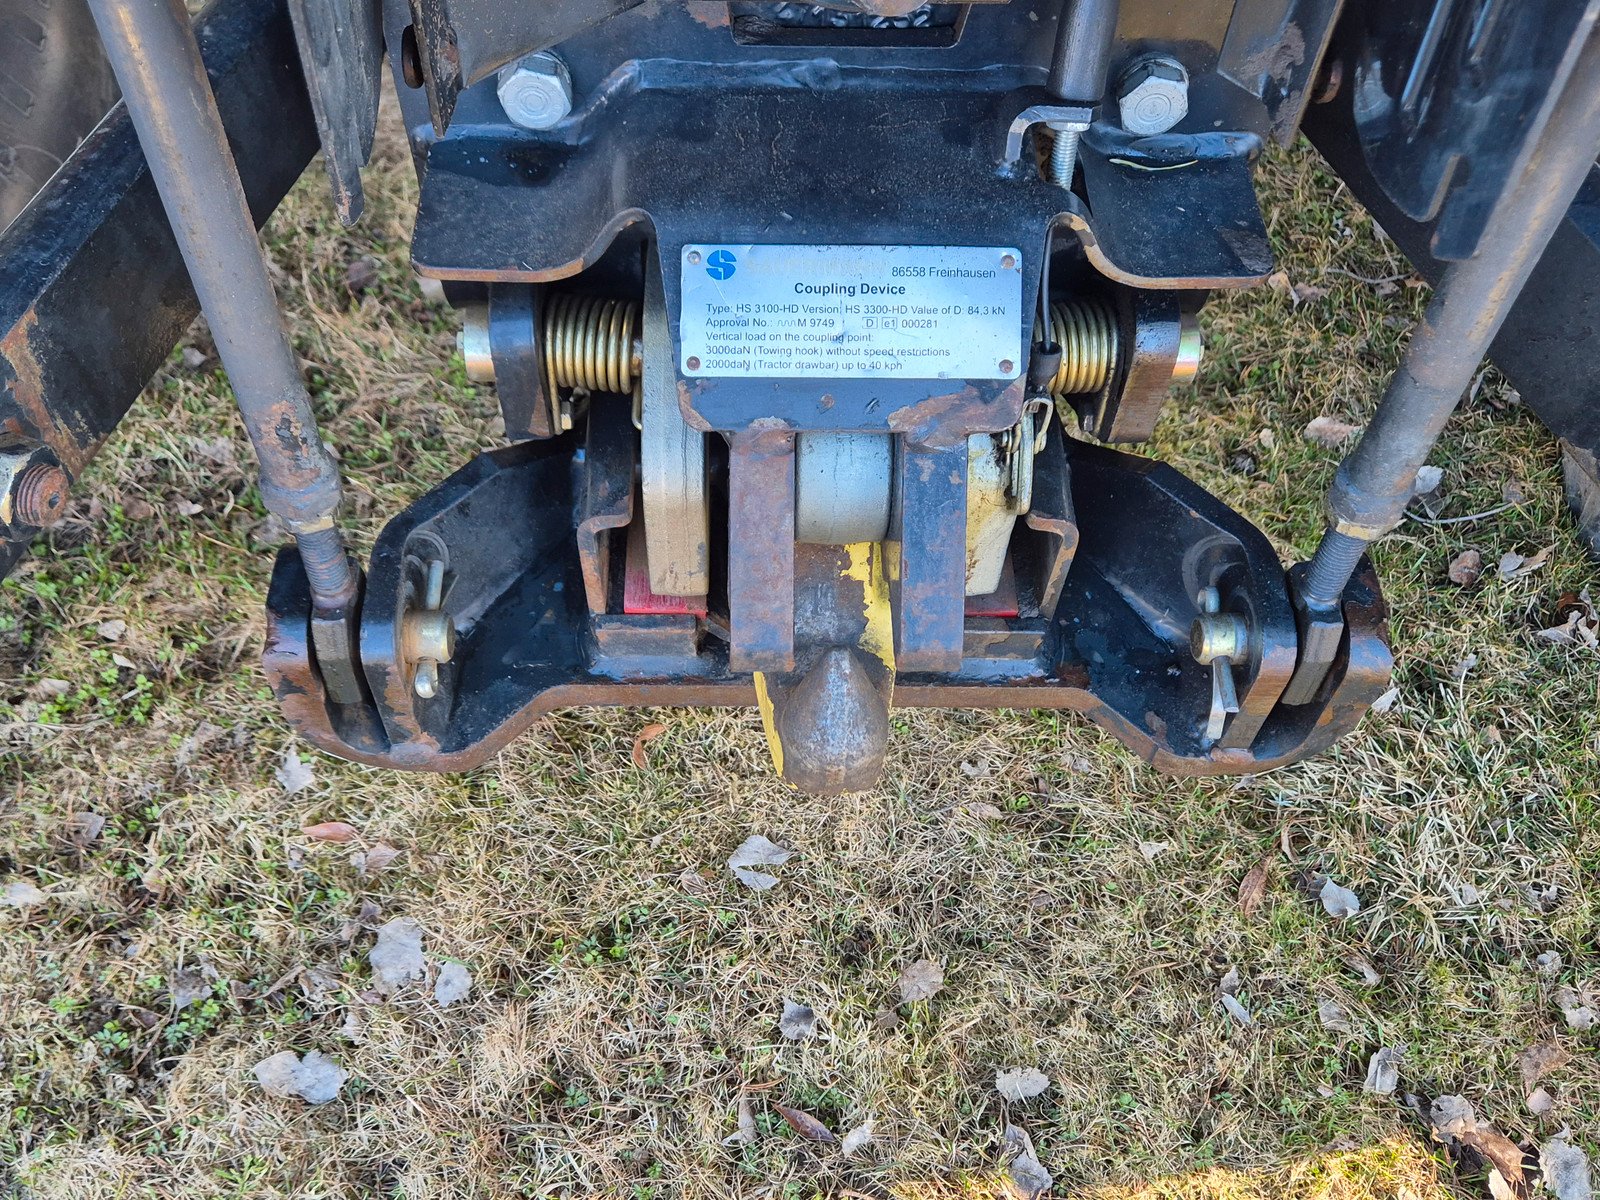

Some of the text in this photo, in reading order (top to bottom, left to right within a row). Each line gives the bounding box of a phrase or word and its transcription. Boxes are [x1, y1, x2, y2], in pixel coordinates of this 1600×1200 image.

[892, 267, 996, 278] 86558 Freinhausen
[795, 282, 905, 297] Coupling Device
[706, 304, 732, 314] Type:
[737, 304, 751, 312] HS
[755, 304, 798, 313] 3100-HD
[802, 305, 842, 314] Version:
[846, 305, 860, 314] HS
[864, 305, 907, 314] 3300-HD
[911, 306, 938, 314] Value
[942, 306, 950, 314] of
[706, 318, 749, 328] Approval
[810, 319, 834, 327] 9749
[884, 320, 895, 328] e1
[902, 320, 938, 328] 000281
[706, 332, 742, 340] Vertical
[785, 333, 800, 341] the
[803, 334, 844, 343] coupling
[848, 334, 873, 343] point:
[706, 346, 750, 354] 3000daN
[754, 346, 792, 356] (Towing
[796, 346, 822, 356] hook)
[826, 347, 861, 355] without
[864, 348, 893, 358] speed
[706, 360, 902, 371] 2000daN (Tractor drawbar) up to 40 kph
